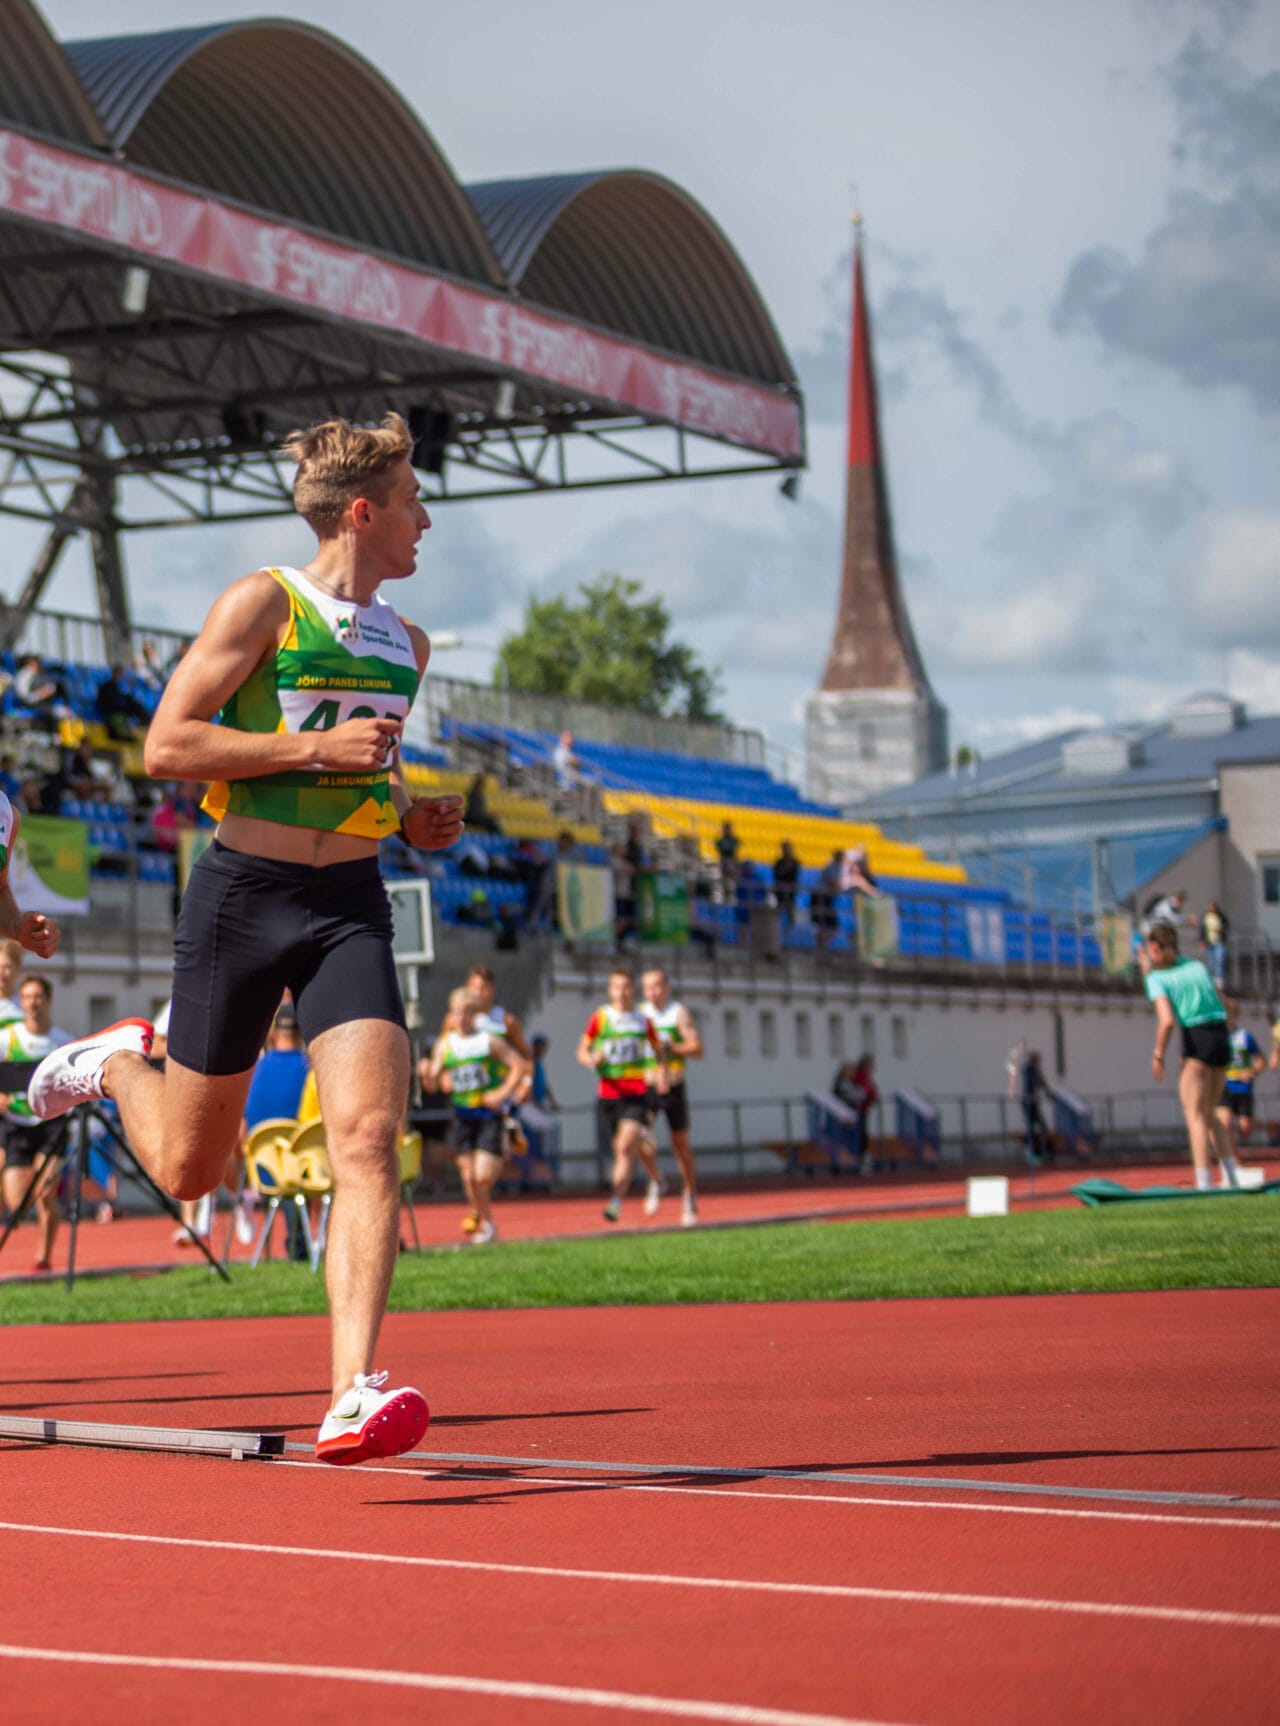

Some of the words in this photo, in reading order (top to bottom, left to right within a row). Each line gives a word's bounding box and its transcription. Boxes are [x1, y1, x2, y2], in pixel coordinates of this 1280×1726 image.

[295, 674, 326, 687] JÕUD
[328, 677, 358, 688] PANEB
[359, 679, 392, 689] LIIKUMA
[316, 776, 329, 786] JA
